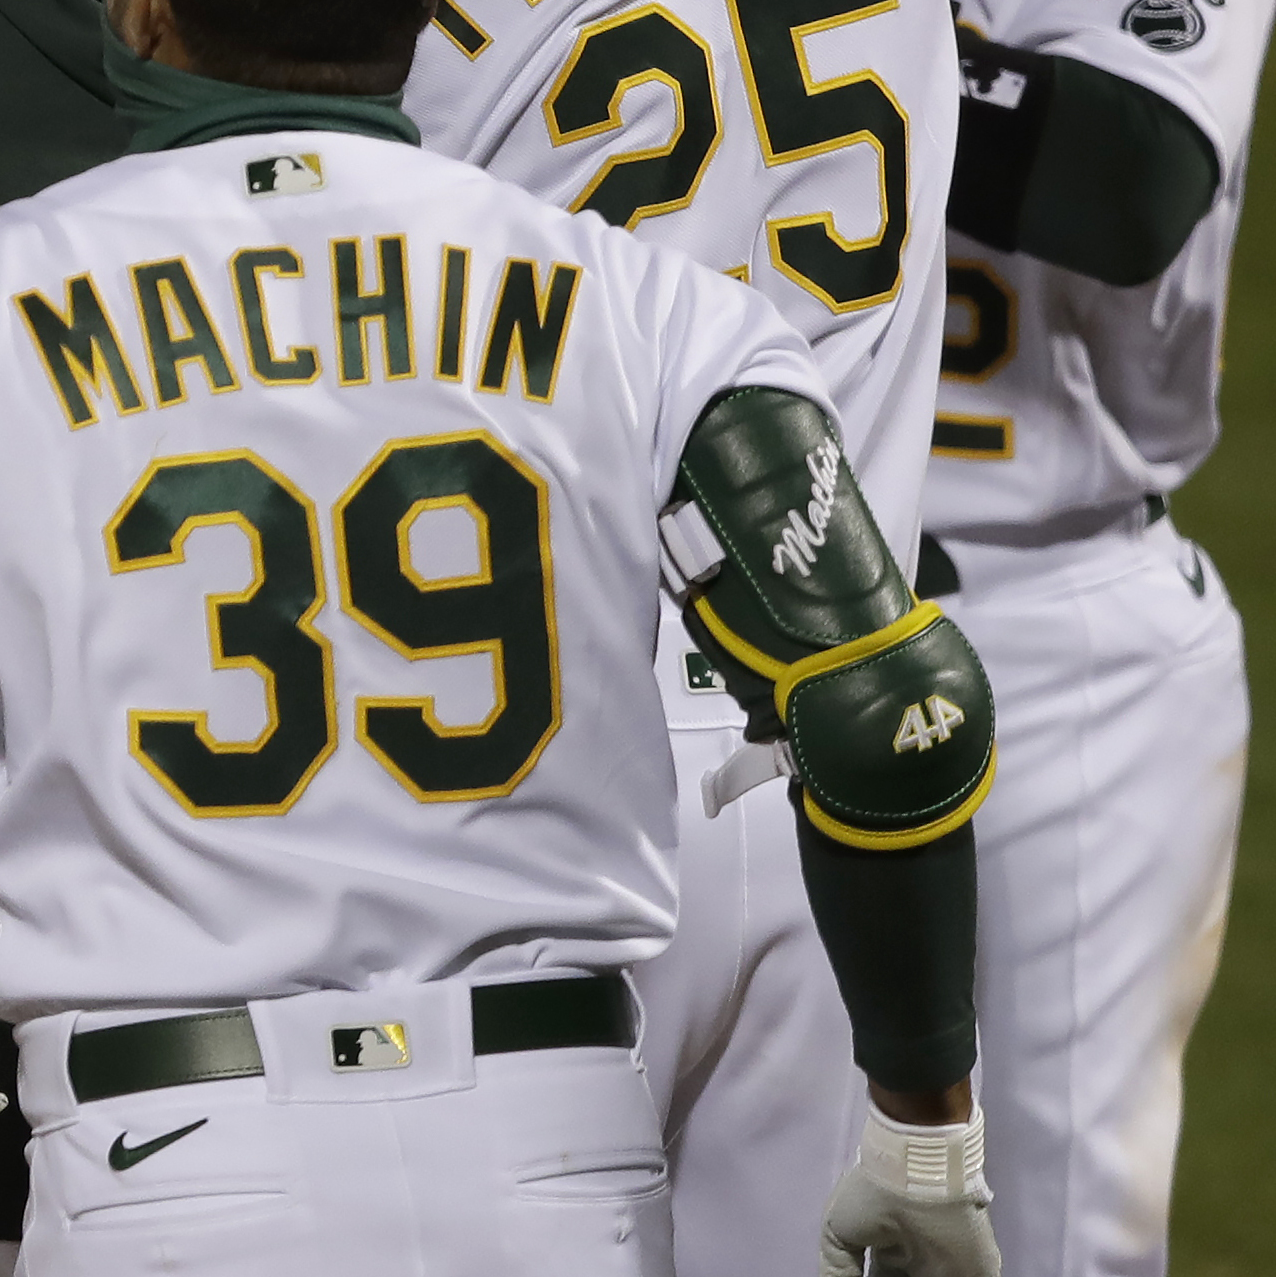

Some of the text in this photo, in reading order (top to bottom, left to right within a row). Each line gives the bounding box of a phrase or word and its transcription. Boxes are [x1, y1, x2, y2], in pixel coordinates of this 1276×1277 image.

[13, 233, 584, 431] MACHIN
[772, 436, 841, 578] Machin
[102, 429, 562, 819] 39
